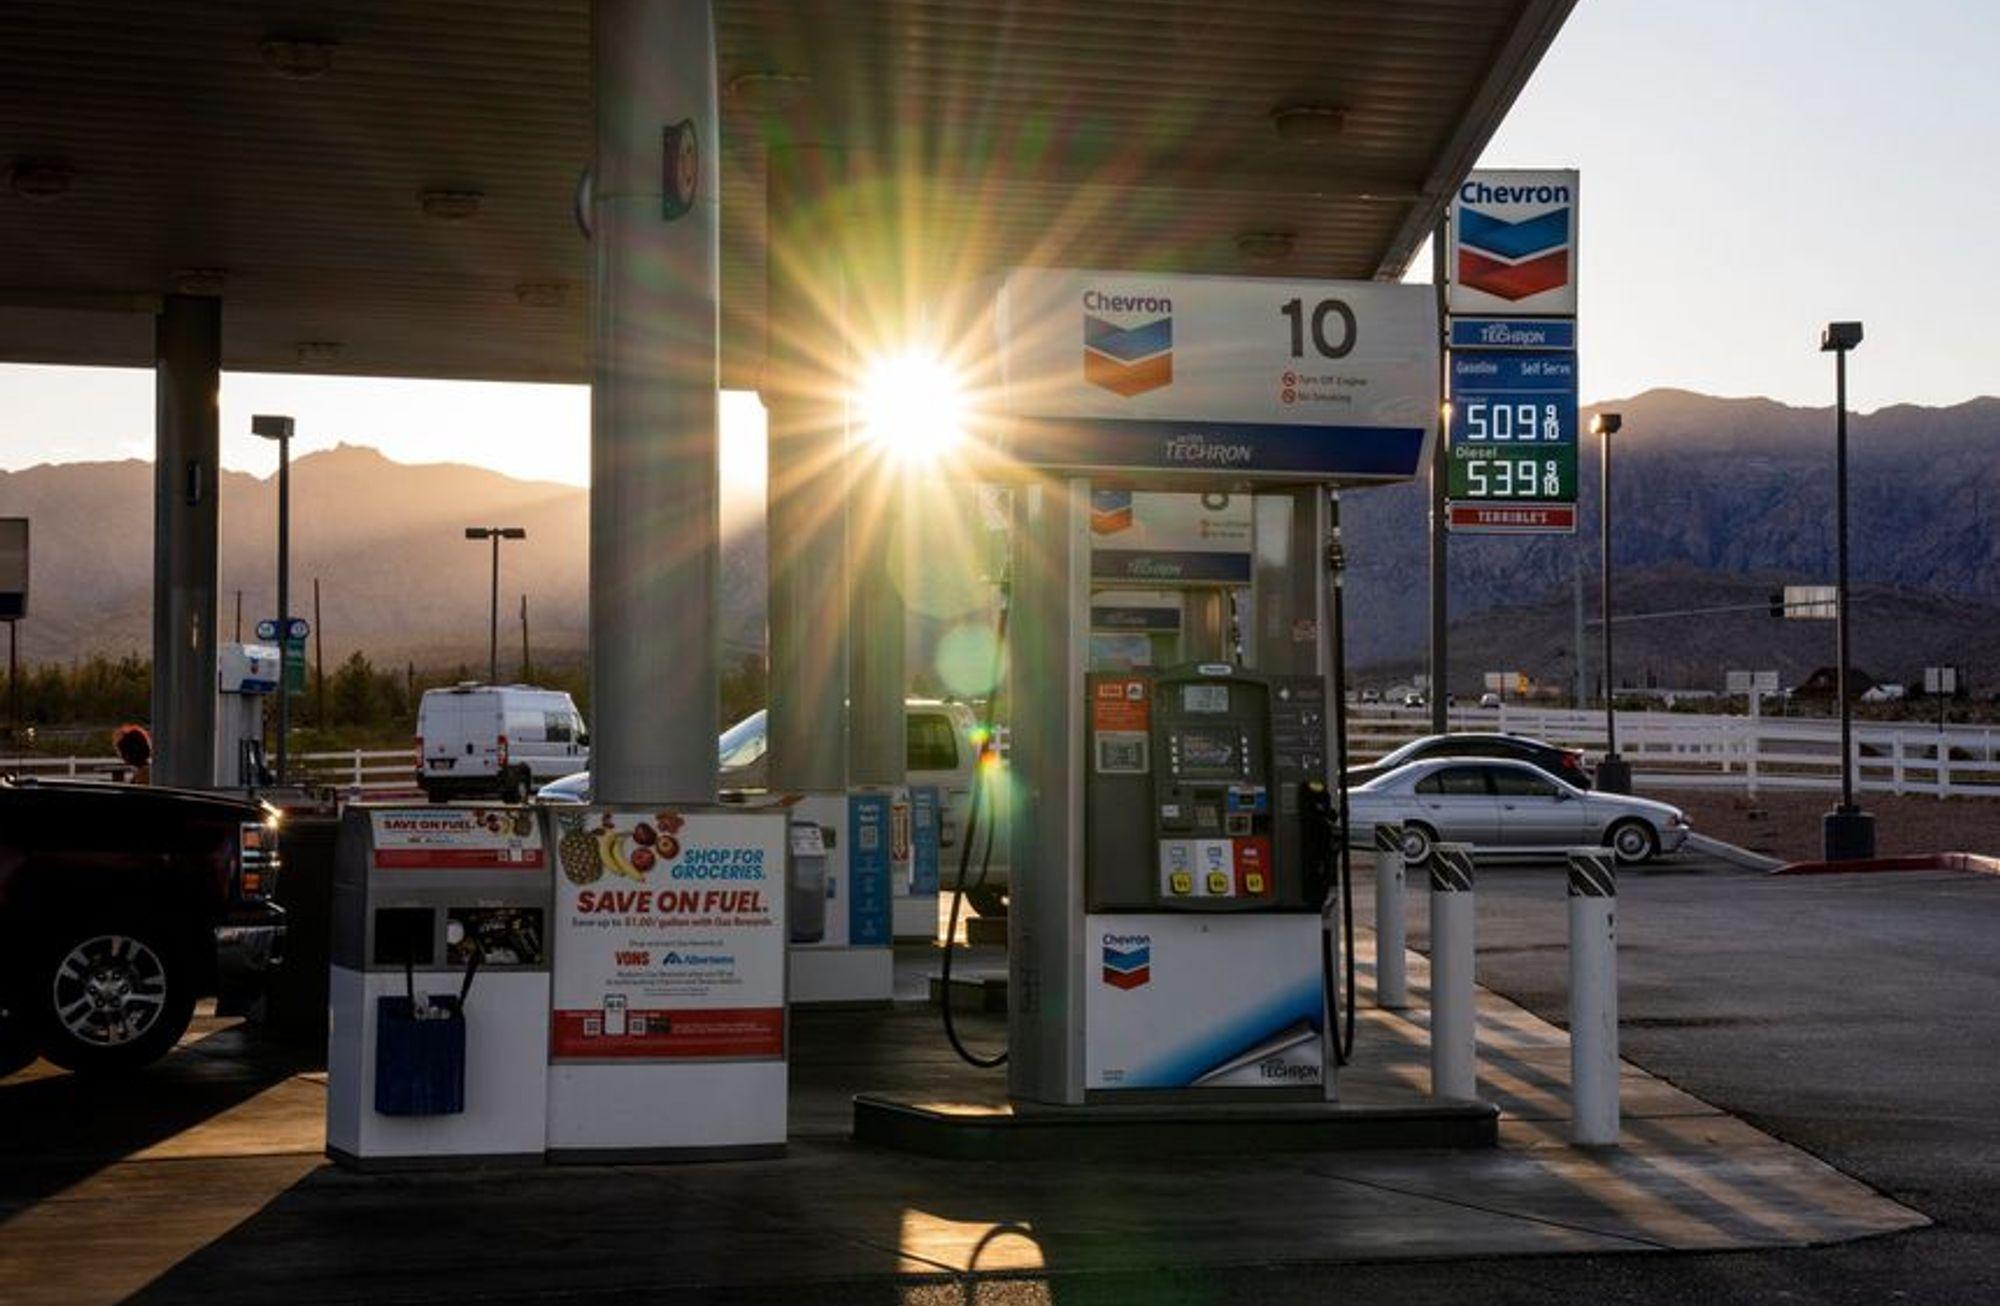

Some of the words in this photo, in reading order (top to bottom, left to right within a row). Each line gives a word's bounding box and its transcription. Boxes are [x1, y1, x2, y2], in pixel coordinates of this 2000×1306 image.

[1460, 181, 1569, 204] Chevron
[1083, 290, 1172, 314] Chevron
[1281, 297, 1357, 360] 10
[1481, 328, 1546, 344] TECHRON
[1456, 361, 1498, 374] Gasoline
[1521, 361, 1541, 375] Self
[1543, 362, 1571, 375] Serve
[1467, 404, 1537, 439] 509
[1166, 440, 1253, 463] TECHRON
[1456, 446, 1498, 459] Diesel
[1467, 460, 1537, 496] 539
[418, 820, 439, 829] ON
[685, 849, 732, 864] SHOP
[733, 849, 765, 864] FOR
[671, 864, 767, 880] GROCERIES.
[577, 890, 652, 913] SAVE
[657, 890, 702, 913] ON
[704, 890, 769, 913] FUEL.
[1102, 934, 1151, 946] Chevron
[615, 951, 650, 967] VONS
[1259, 1065, 1319, 1079] TECHRON
